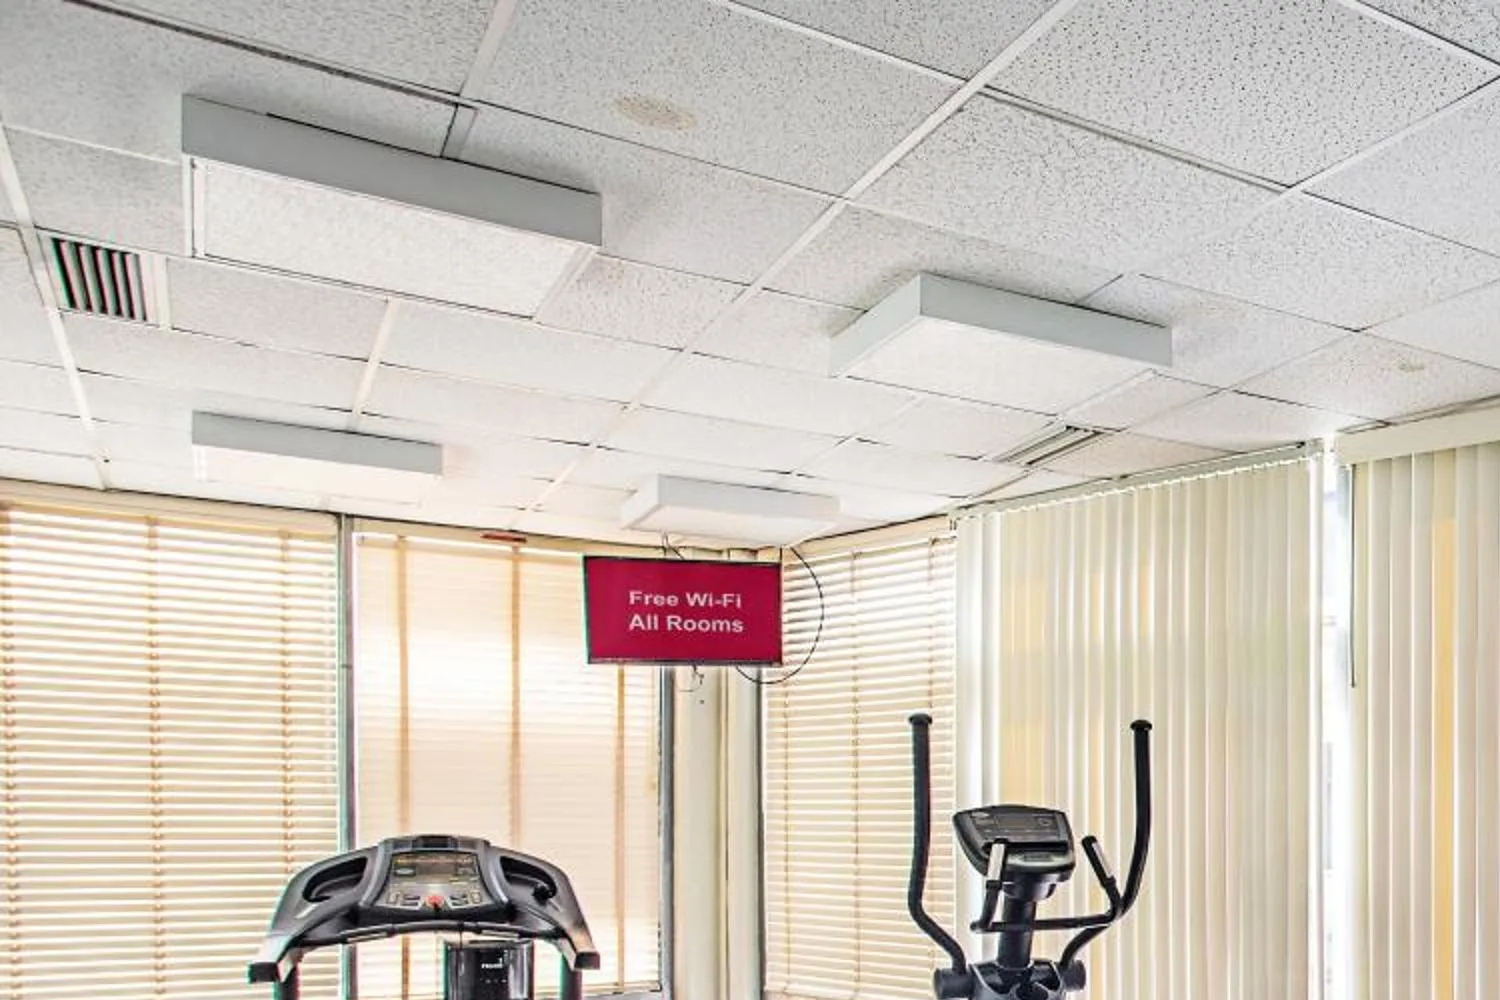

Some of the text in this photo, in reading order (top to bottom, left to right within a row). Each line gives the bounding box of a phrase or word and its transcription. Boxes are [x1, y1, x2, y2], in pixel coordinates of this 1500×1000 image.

[628, 590, 742, 609] Free Wi-Fi
[628, 614, 744, 633] All Rooms
